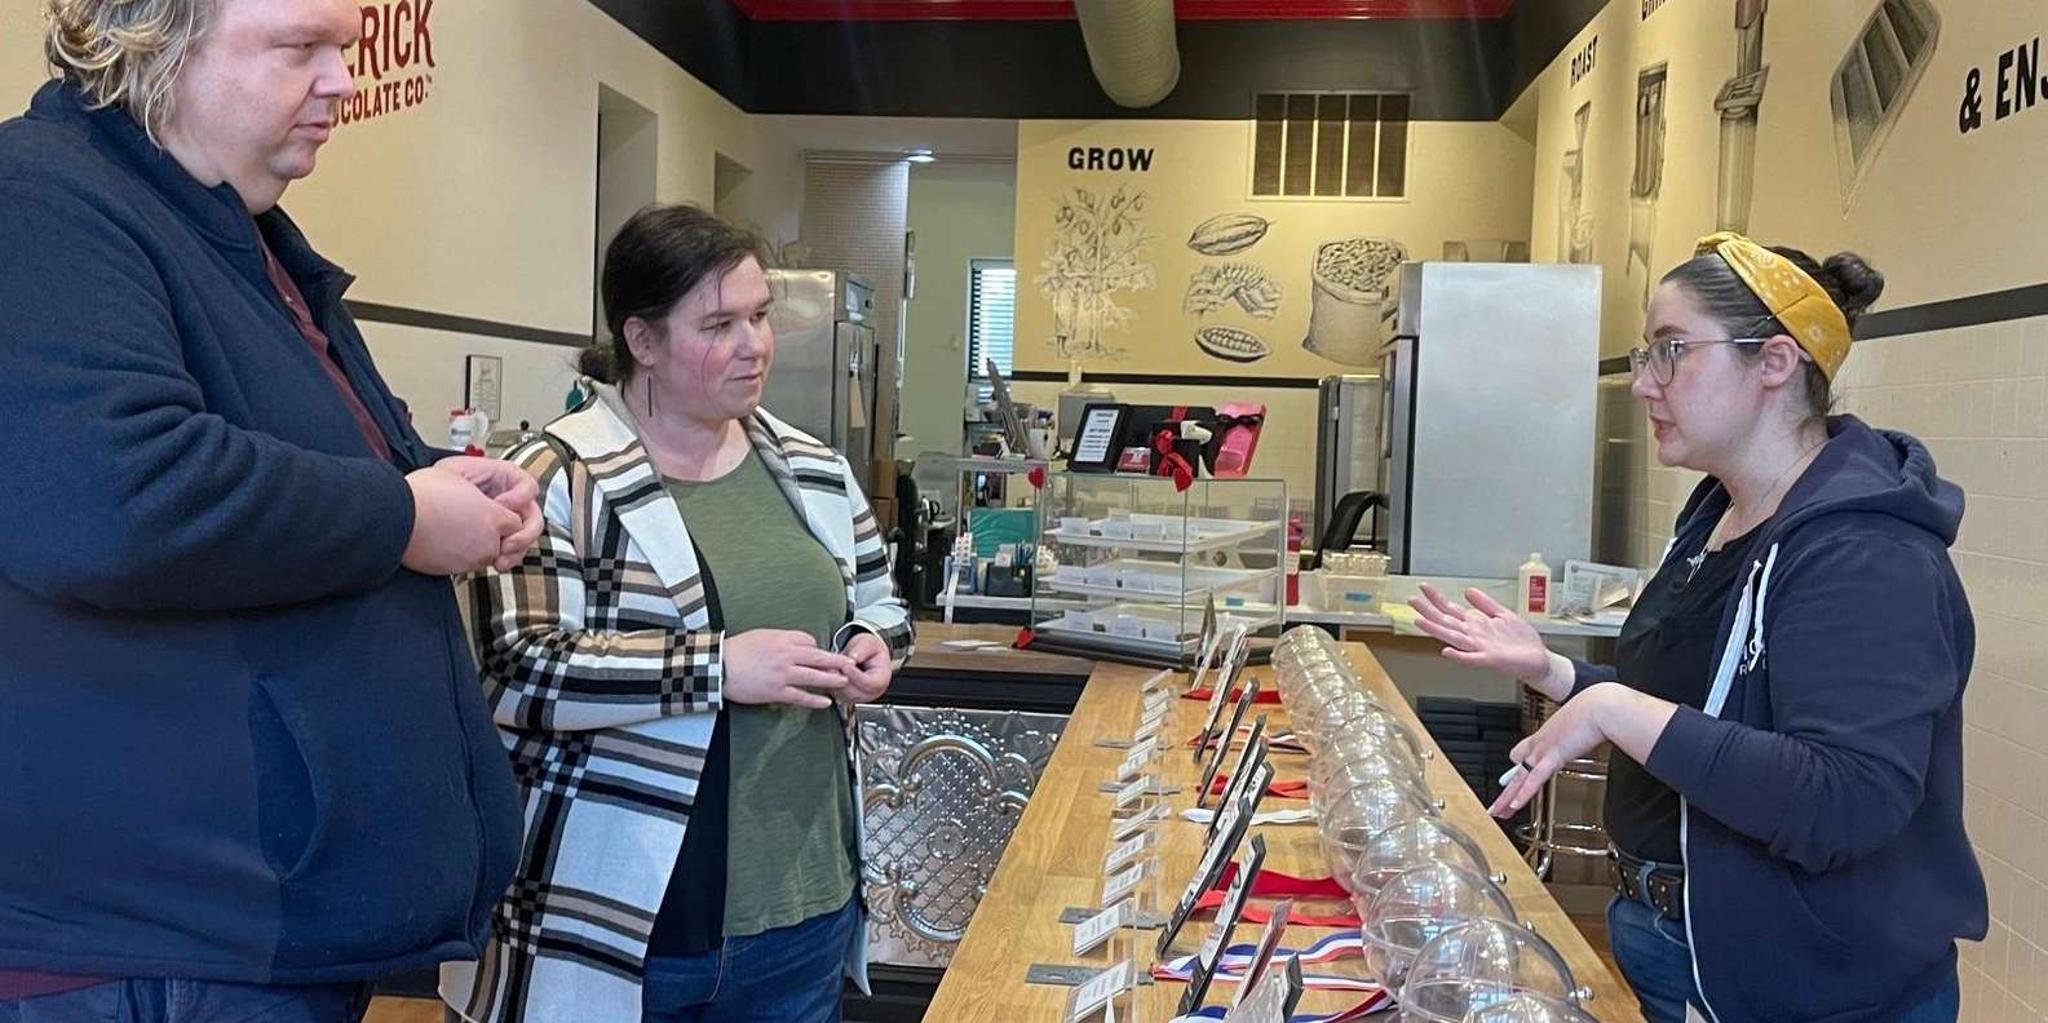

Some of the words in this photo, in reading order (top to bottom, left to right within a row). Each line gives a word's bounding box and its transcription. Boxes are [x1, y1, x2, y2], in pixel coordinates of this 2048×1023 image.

[341, 0, 436, 80] RICK
[1570, 34, 1598, 89] ROAST
[333, 81, 401, 129] COLATE
[1959, 67, 1982, 134] &
[1067, 146, 1155, 172] GROW
